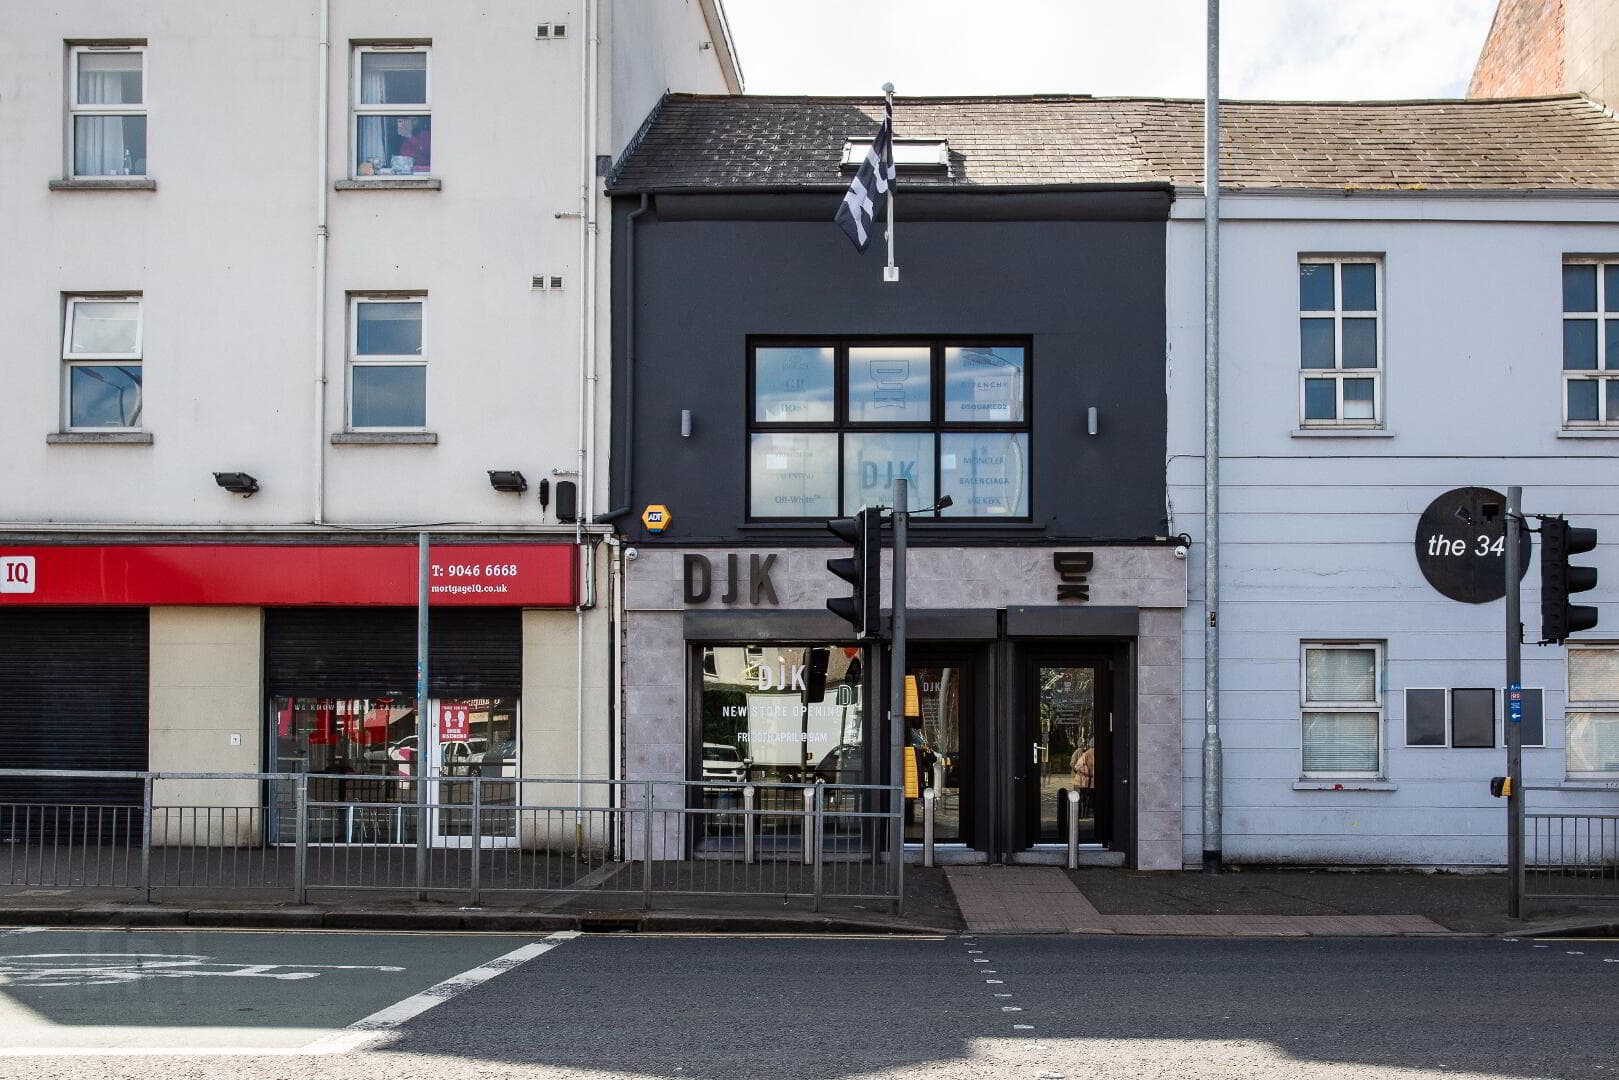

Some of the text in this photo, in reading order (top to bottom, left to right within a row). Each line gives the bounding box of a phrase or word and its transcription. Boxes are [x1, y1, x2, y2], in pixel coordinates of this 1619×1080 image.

[861, 461, 919, 489] DJK
[960, 477, 1009, 485] BALENCIAGA
[648, 512, 662, 521] ADT
[1428, 535, 1521, 557] the 34
[6, 562, 29, 584] IQ
[432, 565, 517, 576] T: 9046 6668
[684, 553, 779, 604] DJK
[431, 584, 508, 594] mortgageIQ.co.uk
[758, 664, 807, 691] DJK
[722, 705, 747, 717] NEW
[750, 705, 787, 717] STORE
[737, 732, 750, 742] FRI
[774, 732, 800, 742] APRIL
[808, 732, 828, 742] 9AM
